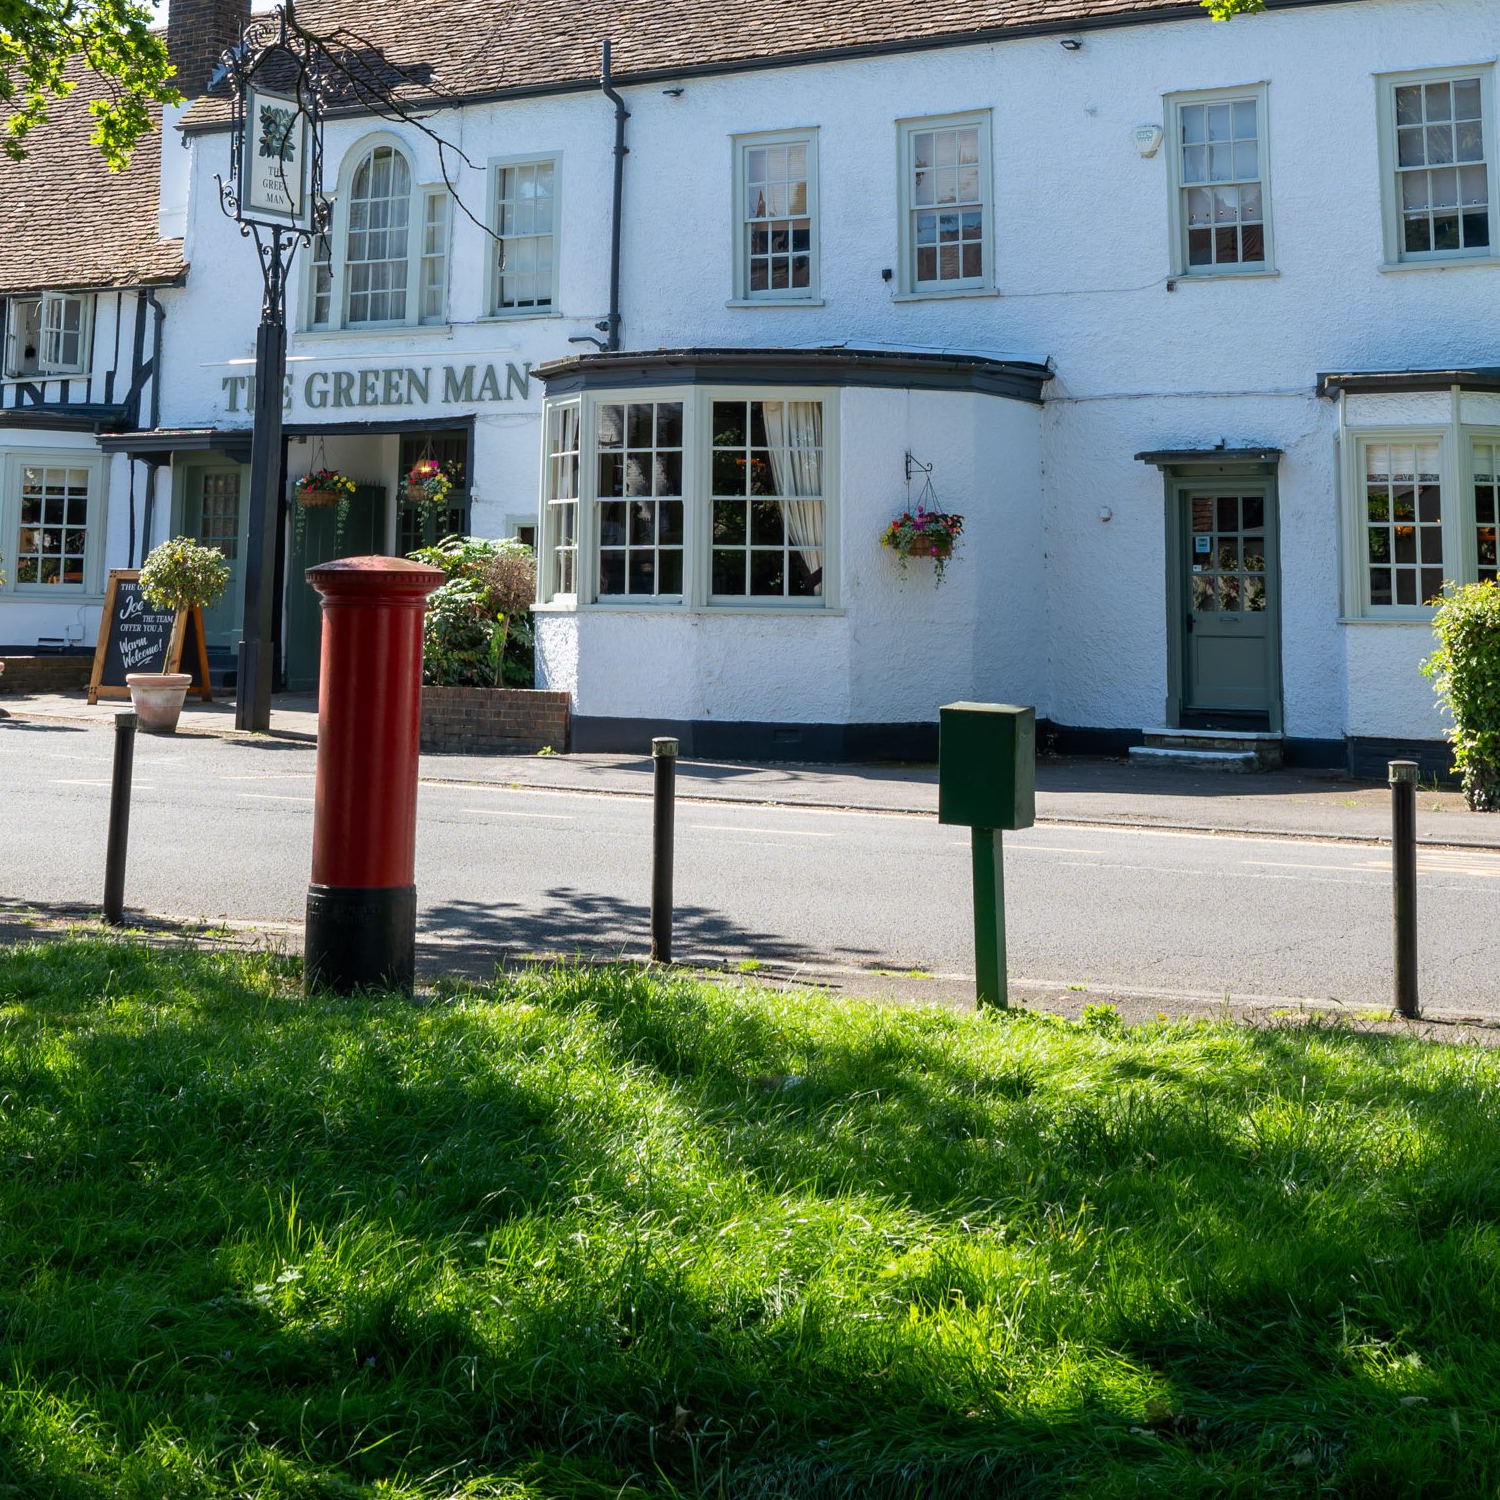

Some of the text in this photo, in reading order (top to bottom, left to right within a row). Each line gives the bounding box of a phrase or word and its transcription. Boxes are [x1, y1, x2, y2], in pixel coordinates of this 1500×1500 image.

[262, 179, 287, 192] GREE
[267, 192, 285, 204] MAN
[304, 367, 432, 409] GREEN
[442, 362, 532, 403] MAN
[120, 583, 137, 591] THE
[120, 595, 144, 619] Joe
[142, 615, 174, 623] THE TEAM
[120, 623, 163, 632] OFFER YOU A
[119, 637, 148, 654] Warm
[122, 638, 162, 668] Welcome!
